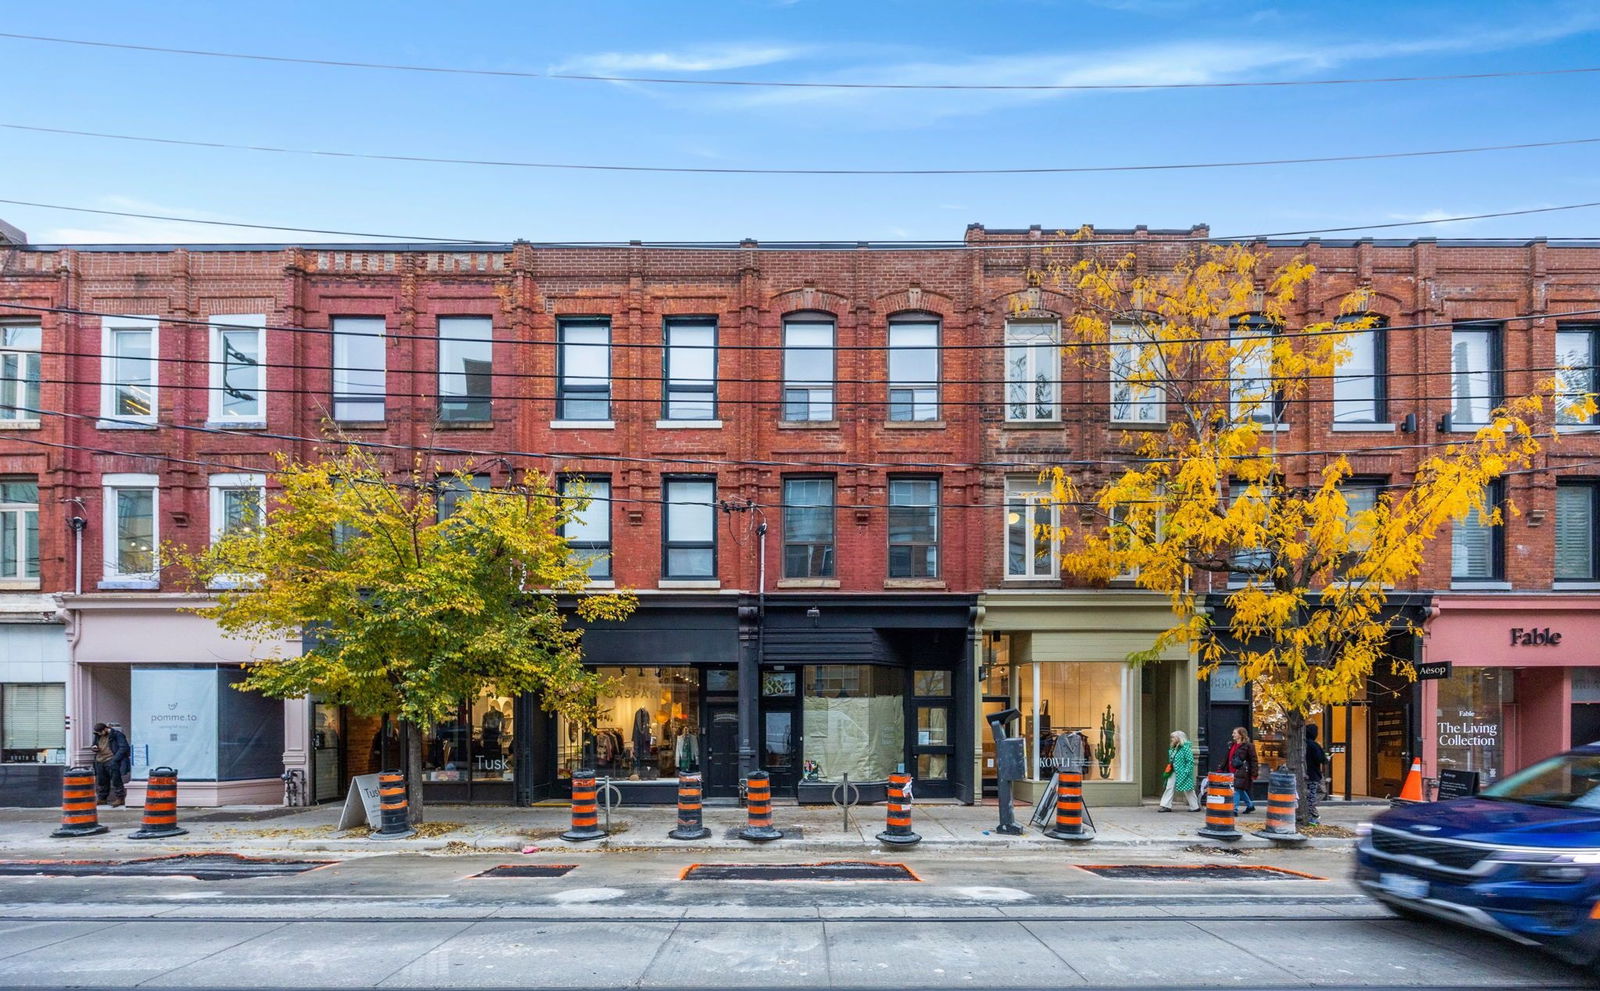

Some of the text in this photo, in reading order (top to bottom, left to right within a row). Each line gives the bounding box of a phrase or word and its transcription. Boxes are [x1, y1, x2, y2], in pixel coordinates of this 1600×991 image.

[1510, 627, 1562, 646] Fable
[765, 679, 795, 695] 884
[151, 714, 197, 724] pomme.to
[1437, 722, 1498, 737] The Living
[1439, 734, 1496, 746] Collection
[475, 754, 510, 770] Tusk
